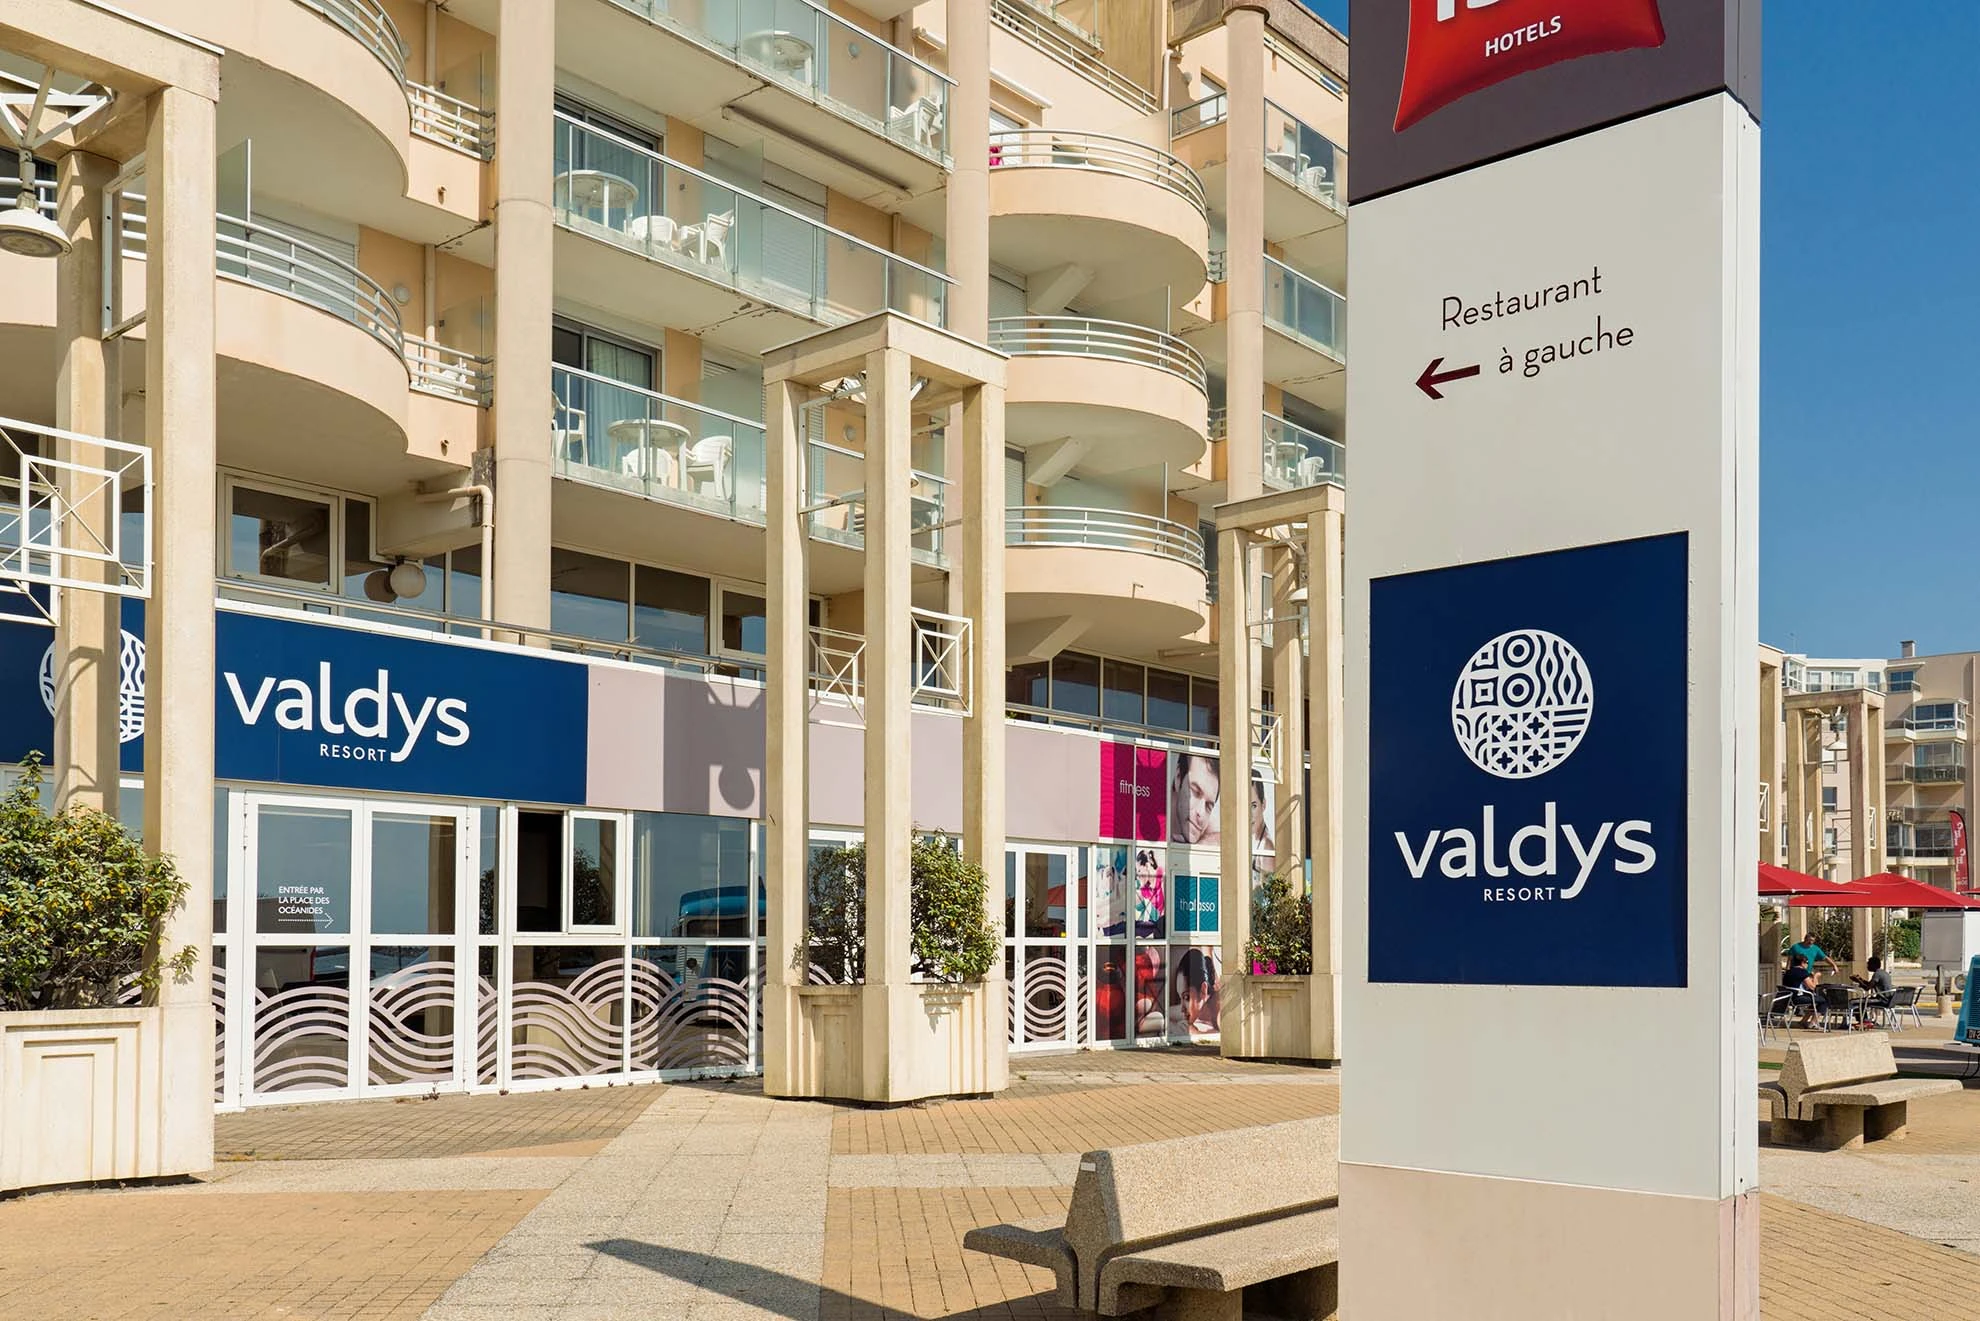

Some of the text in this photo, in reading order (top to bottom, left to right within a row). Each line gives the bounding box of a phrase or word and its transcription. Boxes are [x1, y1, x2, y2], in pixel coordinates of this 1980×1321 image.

[1485, 16, 1562, 56] HOTELS
[1442, 266, 1602, 330] Restaurant
[1500, 315, 1634, 378] à gauche
[223, 660, 470, 763] valdys
[320, 743, 387, 762] RESORT
[1119, 780, 1151, 798] fitness
[1393, 801, 1657, 900] valdys
[278, 884, 324, 894] ENTRÉE PAR
[1483, 886, 1556, 902] RESORT
[278, 896, 289, 904] LA
[290, 896, 314, 904] PLACE
[1180, 898, 1216, 912] thalasso
[278, 905, 324, 914] OCÉANIDES
